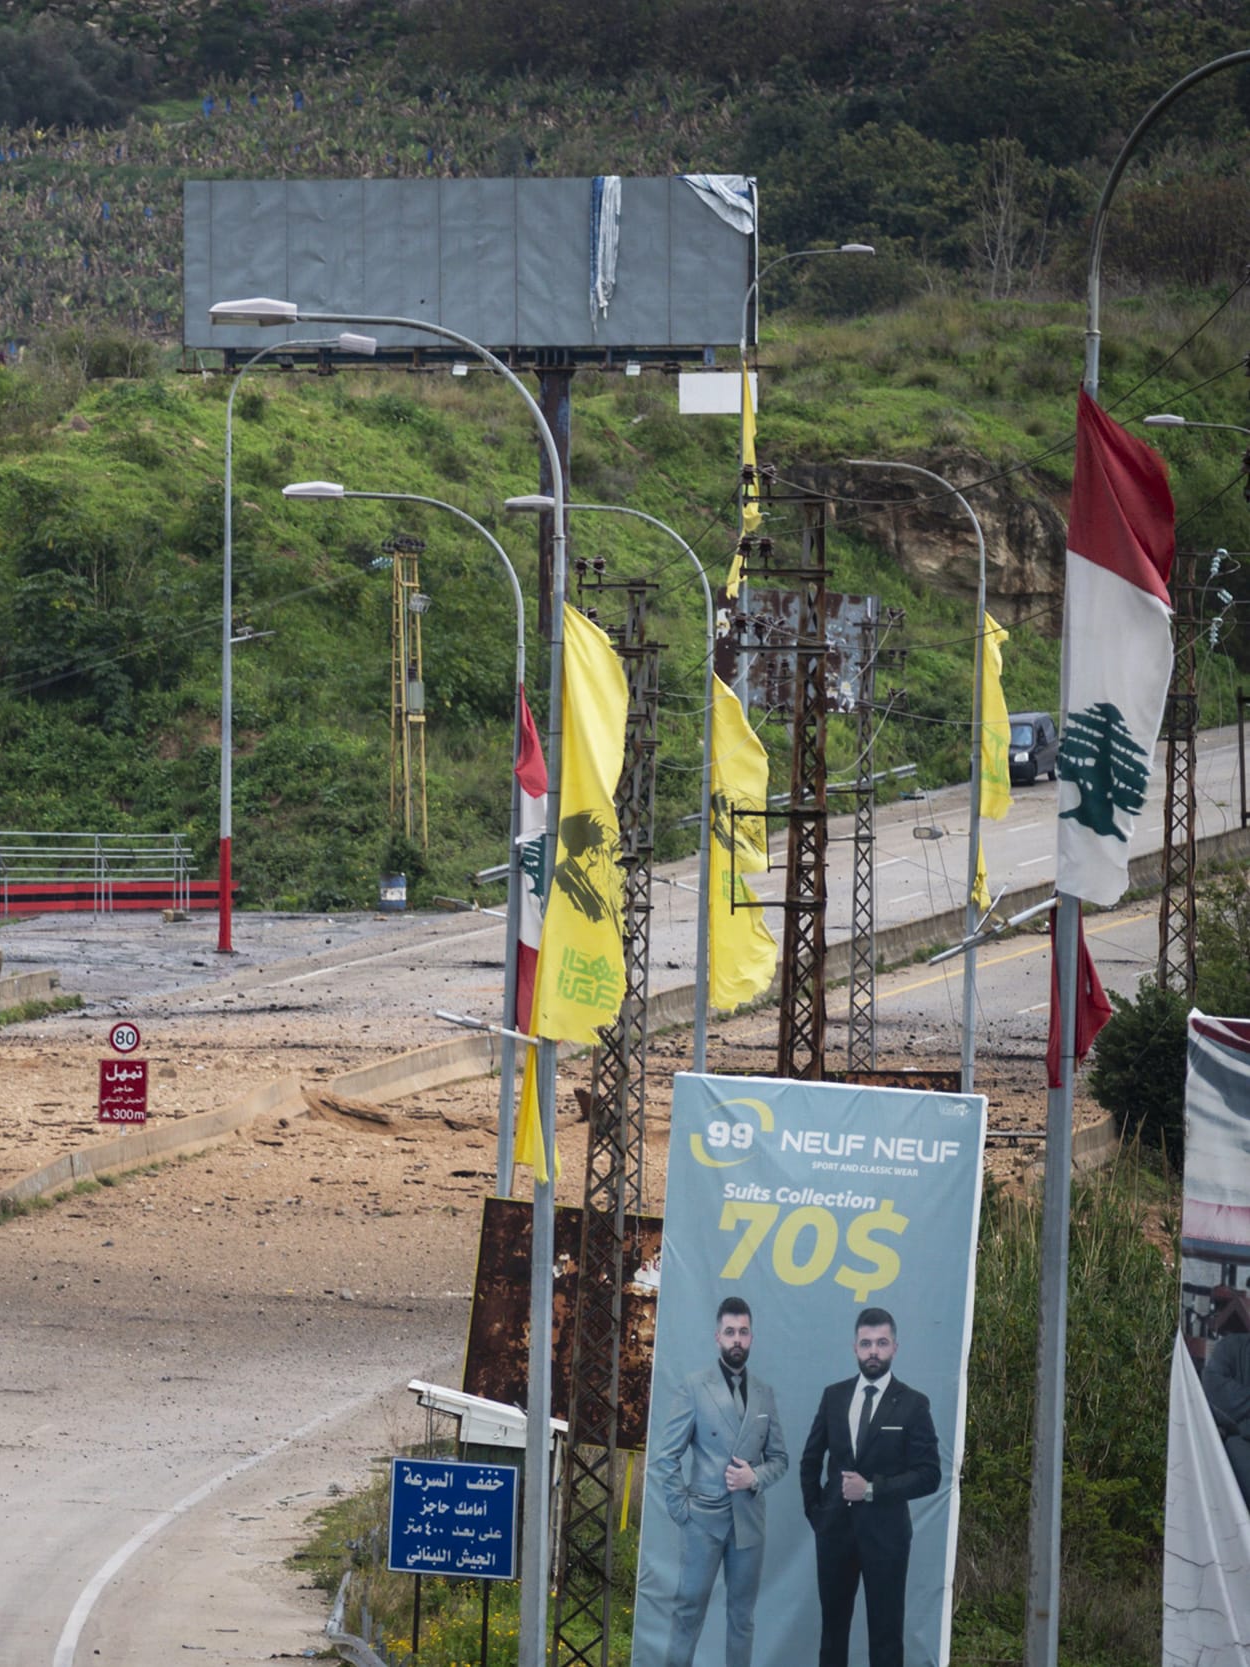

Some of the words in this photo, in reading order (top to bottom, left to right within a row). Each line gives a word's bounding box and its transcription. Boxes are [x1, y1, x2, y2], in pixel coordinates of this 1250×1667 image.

[115, 1030, 136, 1046] 80
[105, 1063, 143, 1082] تمهل
[112, 1084, 134, 1095] حاجز
[707, 1120, 754, 1149] 99
[780, 1129, 866, 1157] NEUF
[873, 1135, 961, 1164] NEUF
[811, 1160, 839, 1171] SPORT
[839, 1162, 859, 1173] AND
[859, 1164, 893, 1175] CLASSIC
[893, 1167, 919, 1177] WEAR
[723, 1182, 771, 1202] Suits
[775, 1186, 877, 1210] Collection
[718, 1199, 911, 1303] 70$
[402, 1466, 454, 1493] السرعة
[466, 1469, 505, 1492] خفف
[419, 1496, 450, 1518] حاجز
[454, 1500, 488, 1517] أمامك
[403, 1518, 423, 1535] متر
[451, 1526, 476, 1545] بعد
[478, 1527, 503, 1542] على
[406, 1545, 452, 1567] اللبناني
[455, 1548, 496, 1571] الجيش
